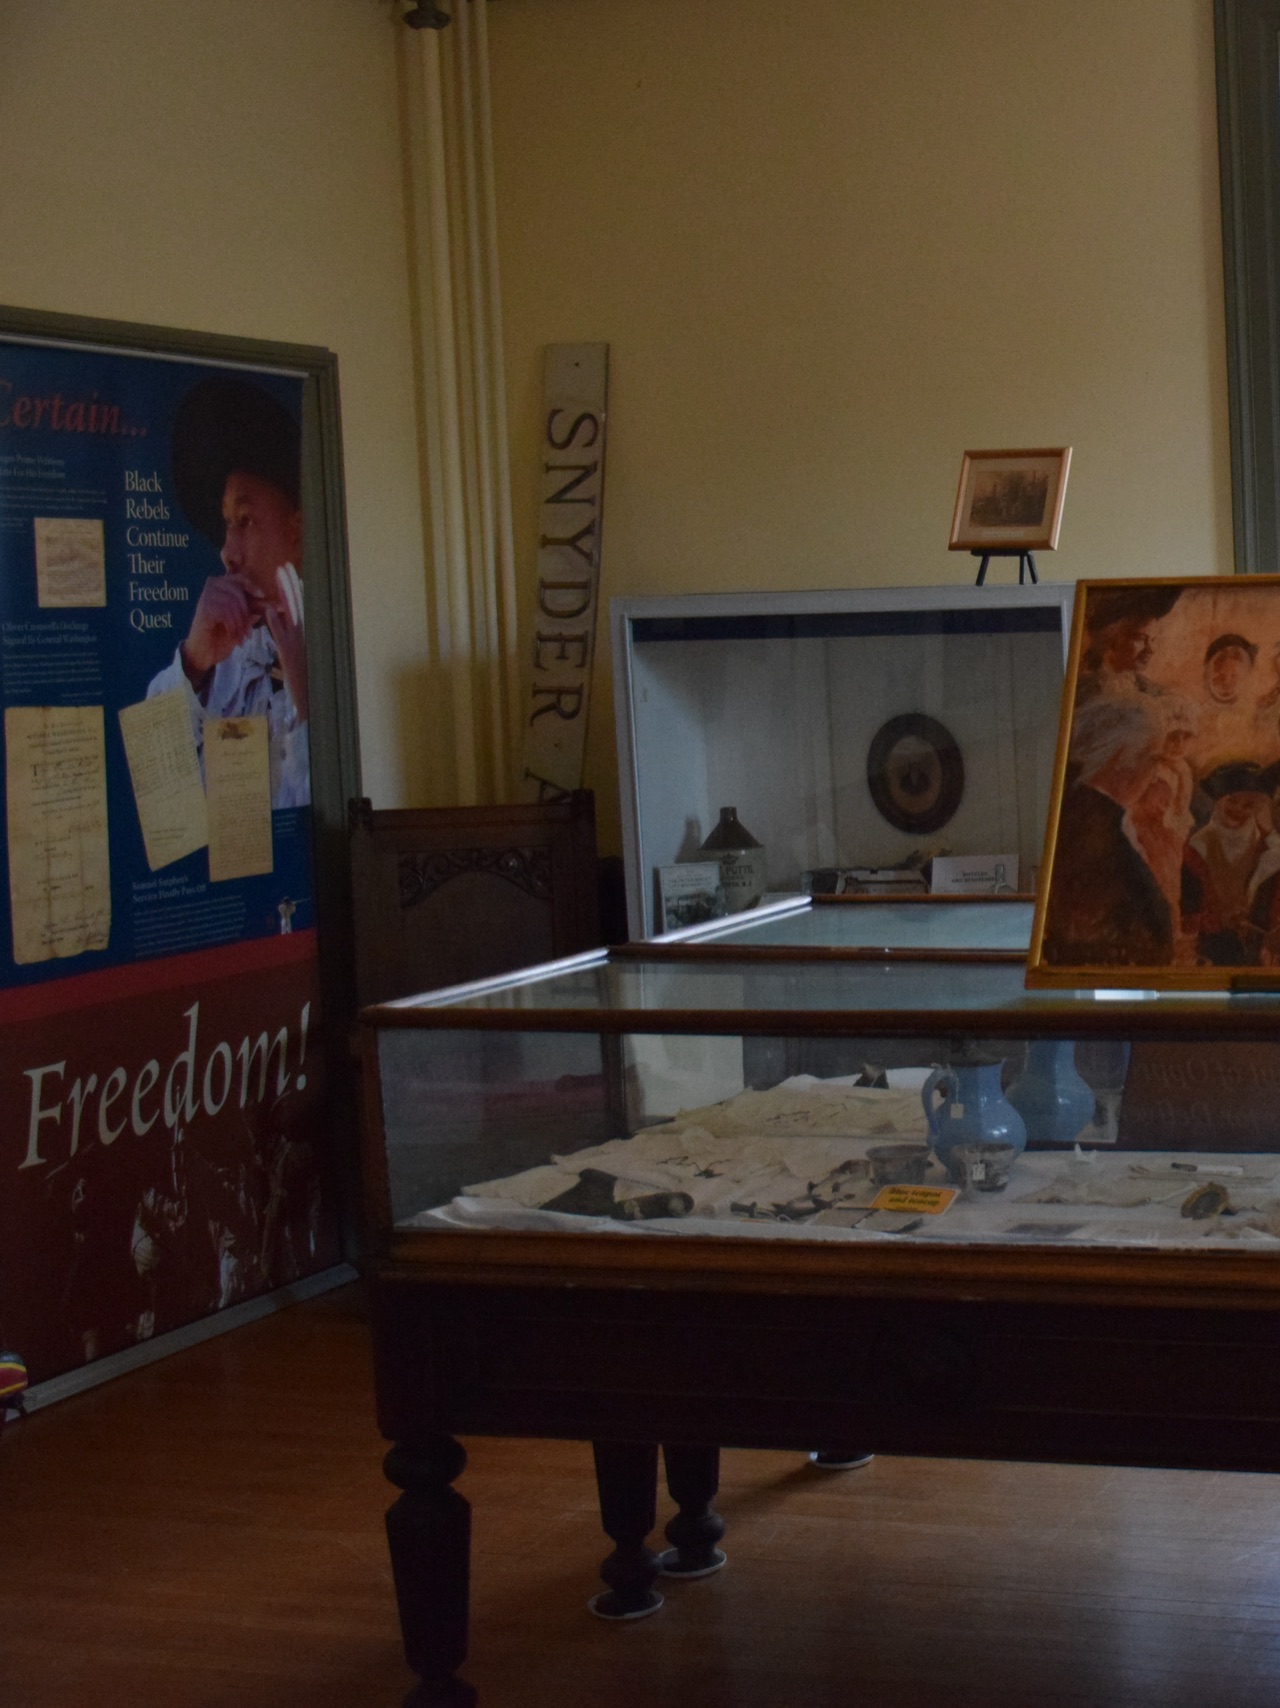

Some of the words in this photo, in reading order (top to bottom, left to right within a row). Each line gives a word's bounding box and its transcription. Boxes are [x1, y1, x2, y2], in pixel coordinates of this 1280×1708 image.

[125, 470, 163, 492] Black
[126, 498, 170, 520] Rebels
[126, 525, 189, 548] Continue
[127, 553, 166, 574] Their
[530, 408, 599, 727] SNYDER
[129, 580, 189, 601] Freedom
[130, 608, 173, 632] Quest
[17, 1000, 312, 1171] Freedom!
